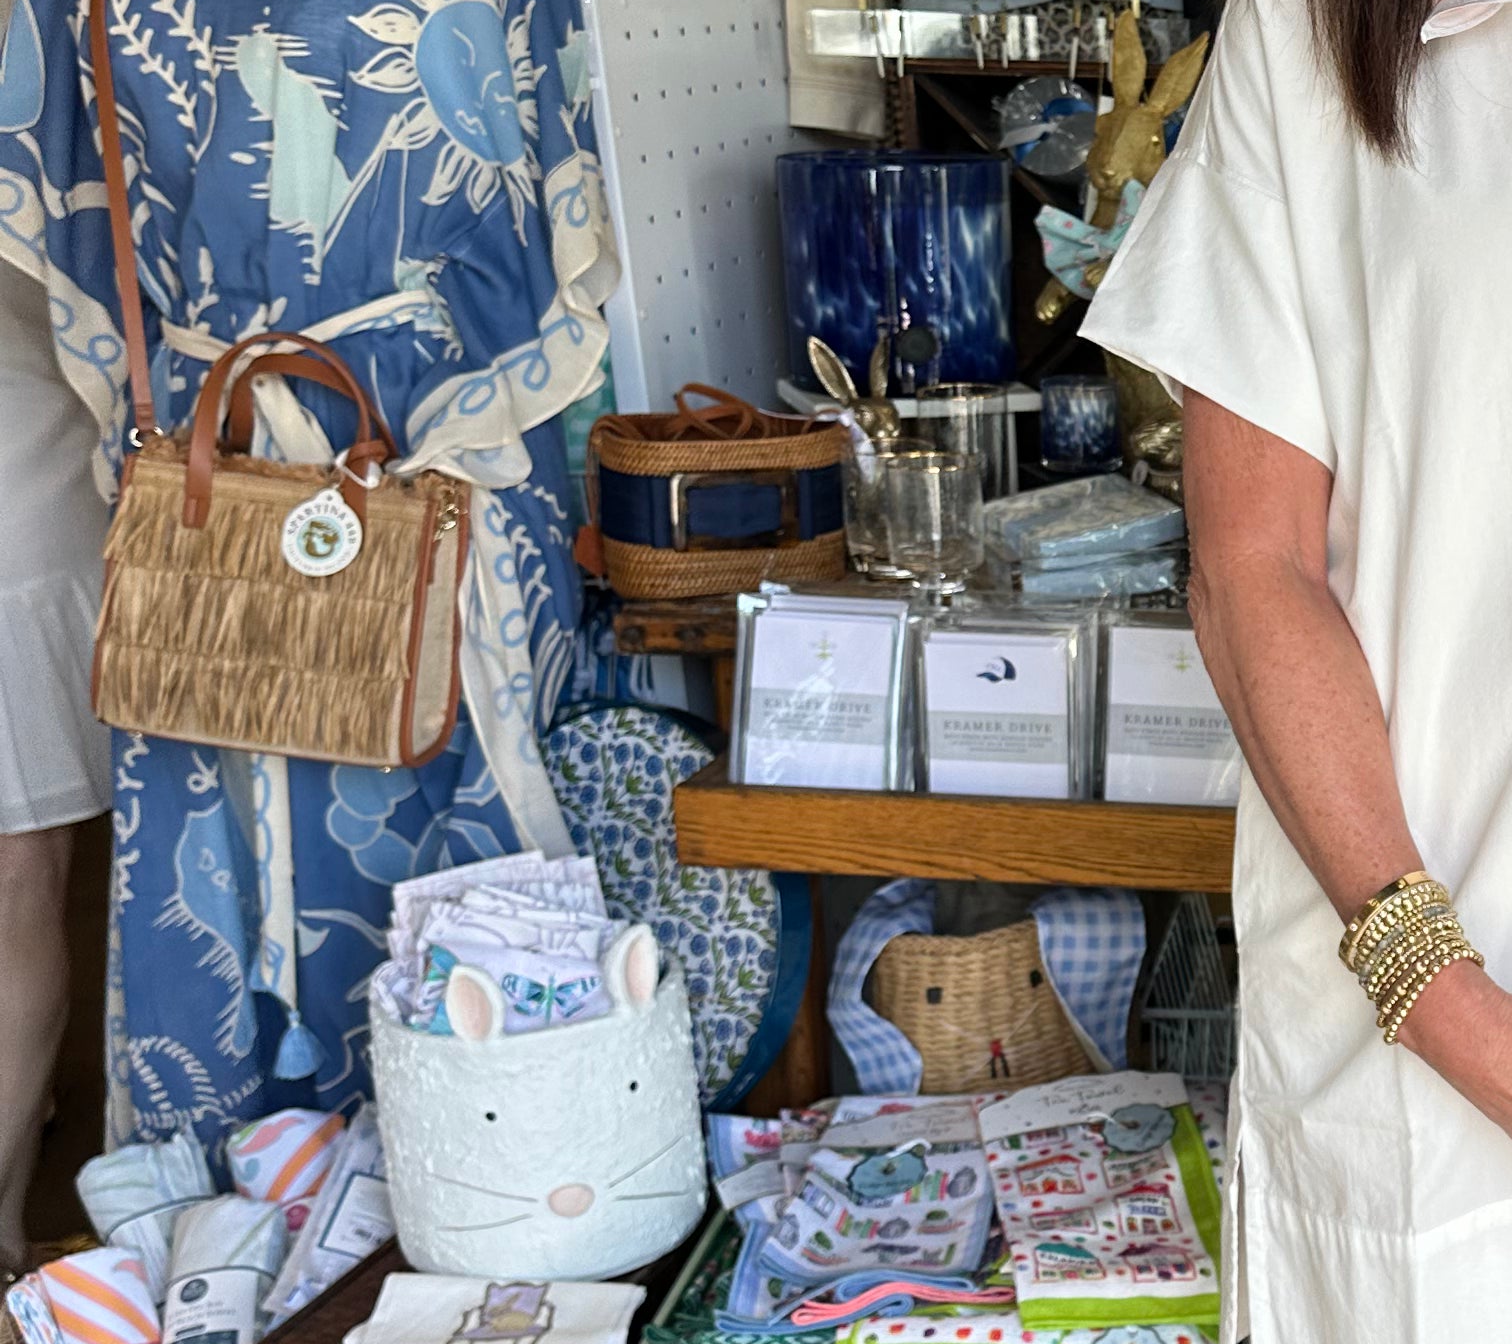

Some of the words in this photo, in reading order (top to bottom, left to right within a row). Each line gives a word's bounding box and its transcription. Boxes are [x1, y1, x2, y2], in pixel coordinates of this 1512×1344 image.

[943, 719, 1003, 733] KRAMER
[1008, 721, 1054, 735] DRIVE
[1124, 713, 1183, 727] KRAMER
